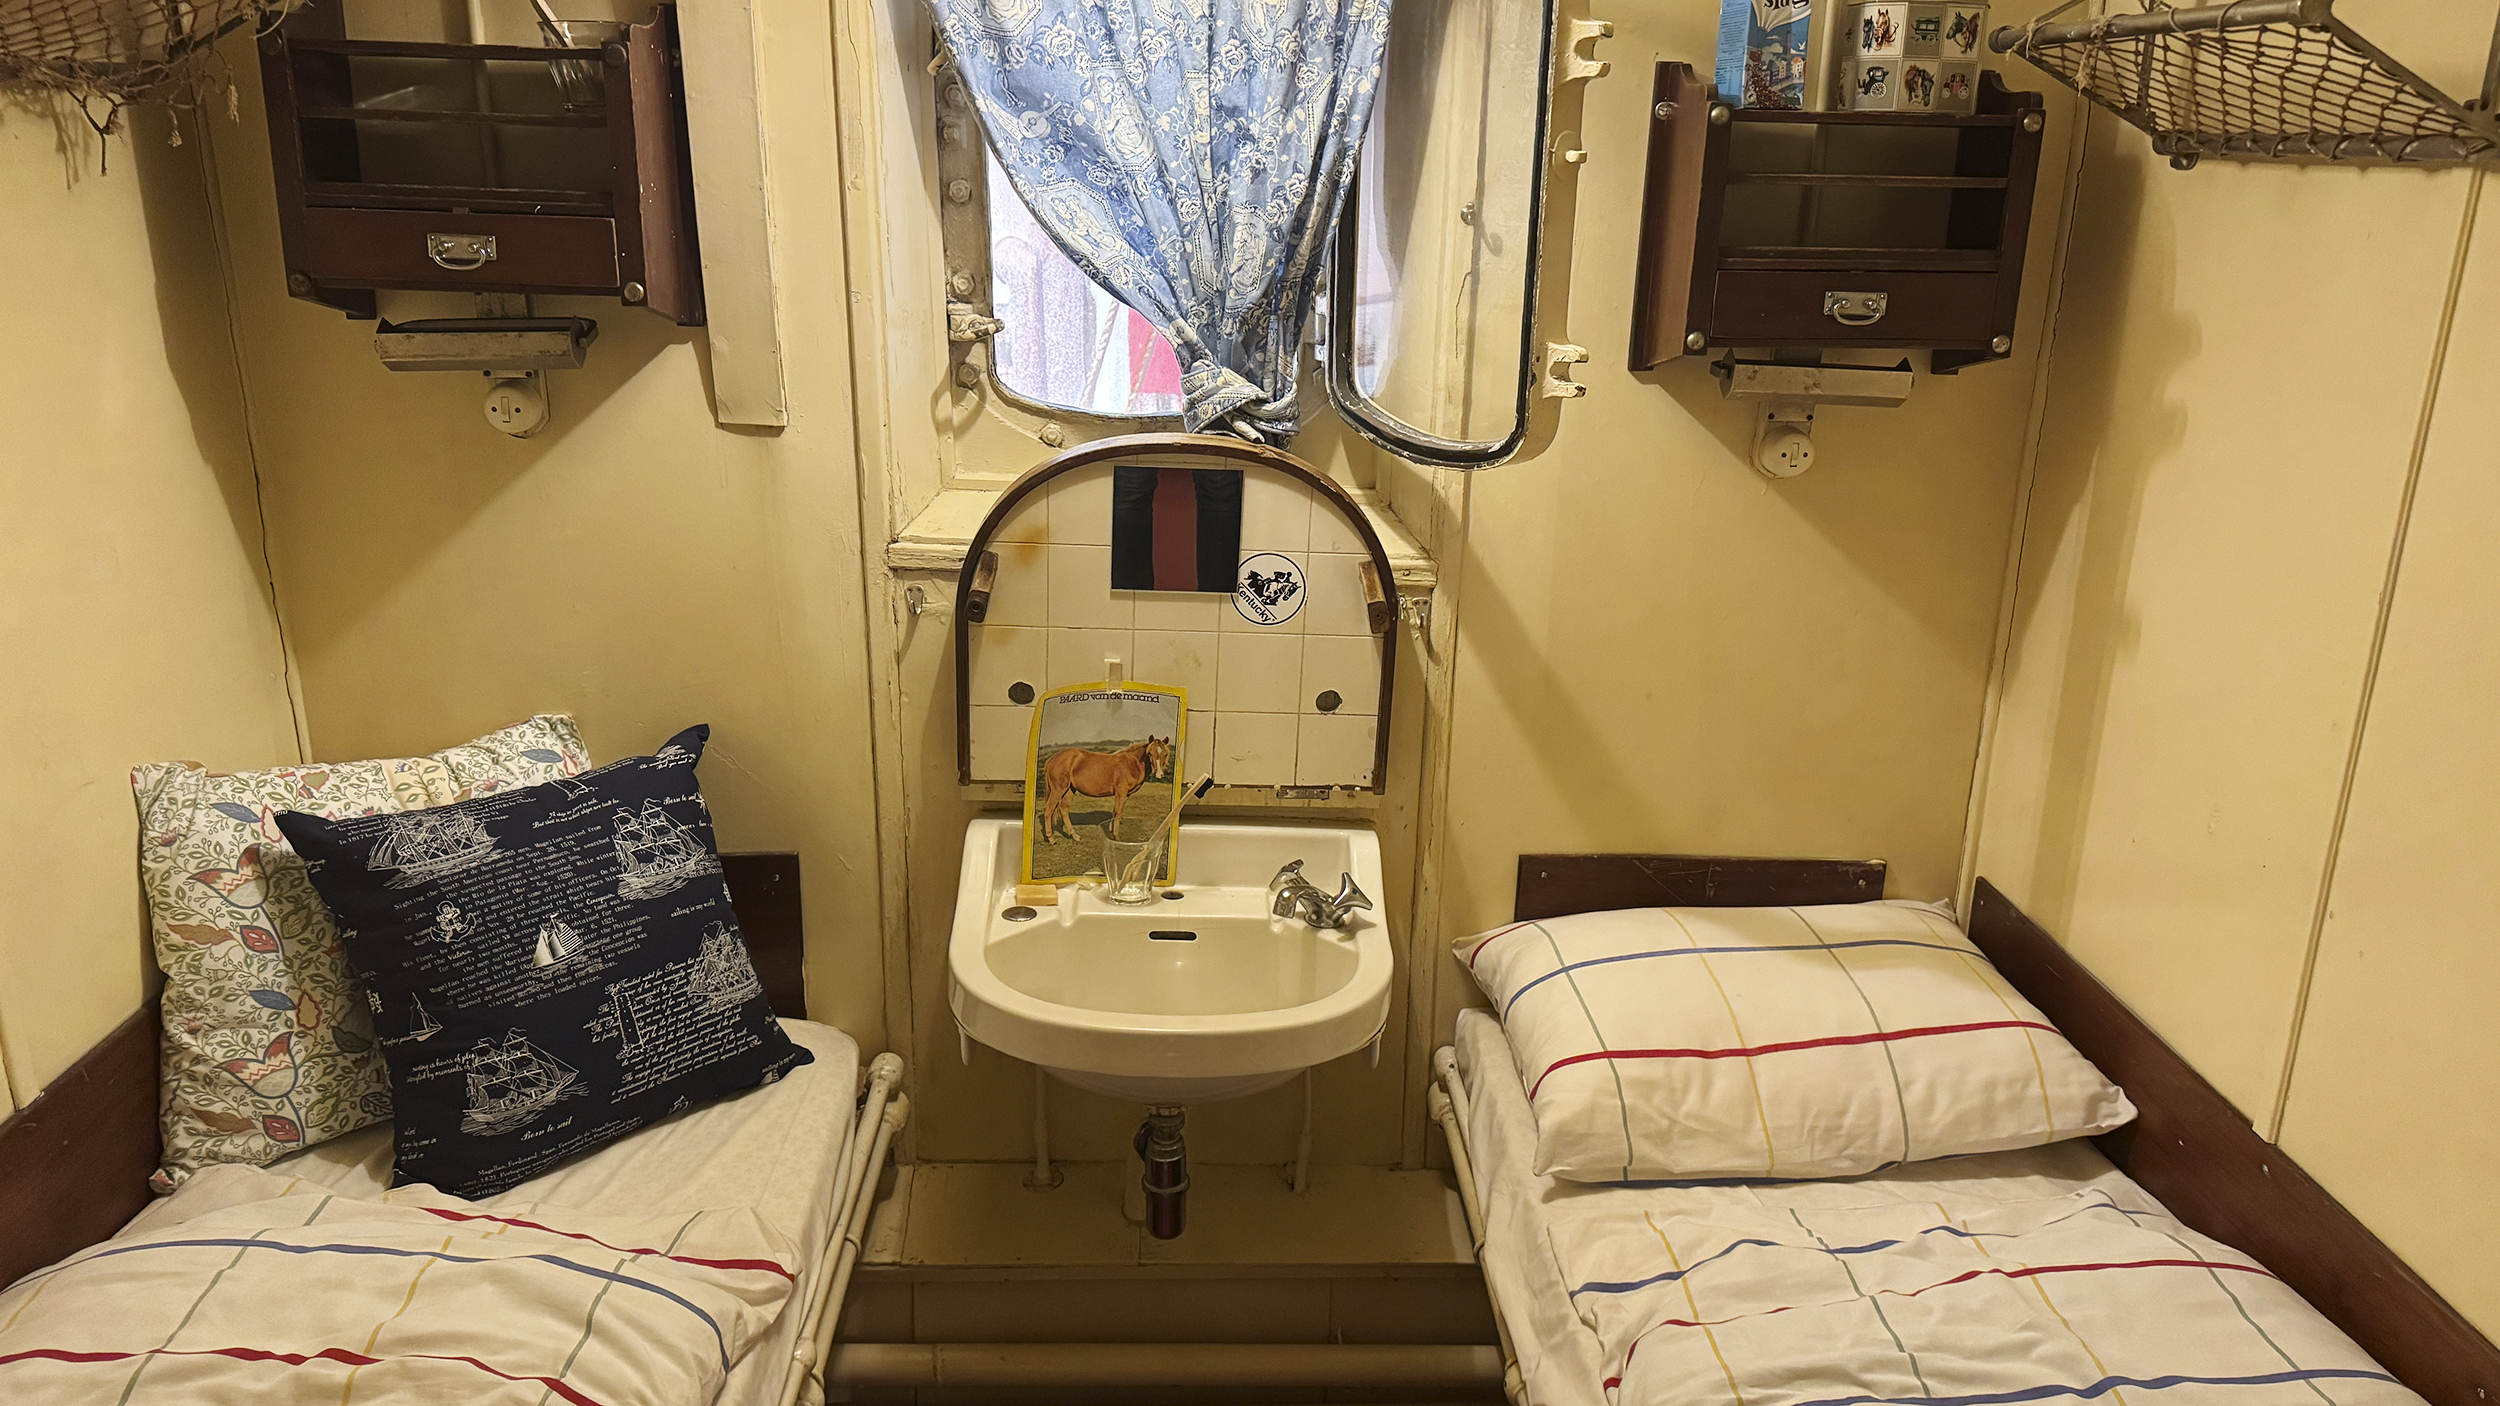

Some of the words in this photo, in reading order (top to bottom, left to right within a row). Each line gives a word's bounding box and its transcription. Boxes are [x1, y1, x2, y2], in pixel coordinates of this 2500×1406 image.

[1059, 693, 1090, 704] PAARD
[1091, 692, 1110, 702] van
[1110, 692, 1122, 701] de
[1123, 693, 1160, 704] maand
